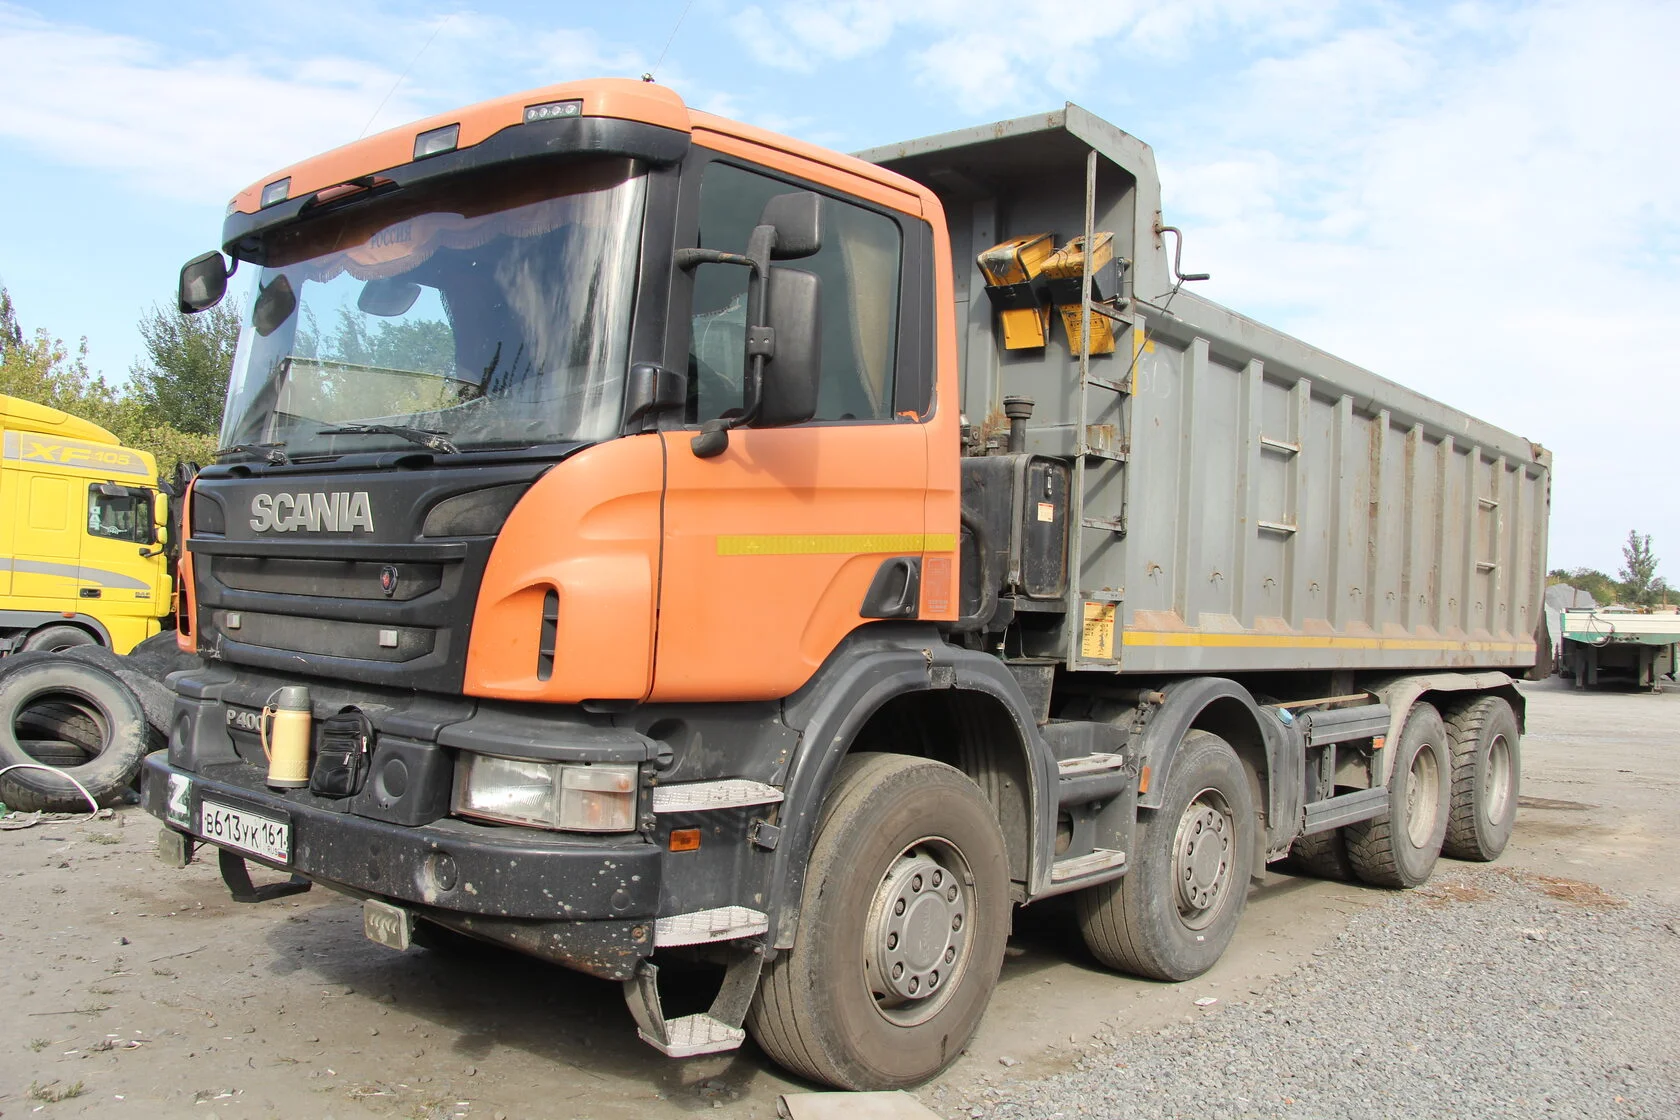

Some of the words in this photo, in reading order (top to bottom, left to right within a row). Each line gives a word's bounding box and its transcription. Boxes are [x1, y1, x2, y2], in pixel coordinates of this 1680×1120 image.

[26, 442, 92, 463] XF
[96, 451, 131, 465] 105
[249, 491, 374, 533] SCANIA
[170, 773, 190, 814] Z
[261, 822, 284, 849] 161
